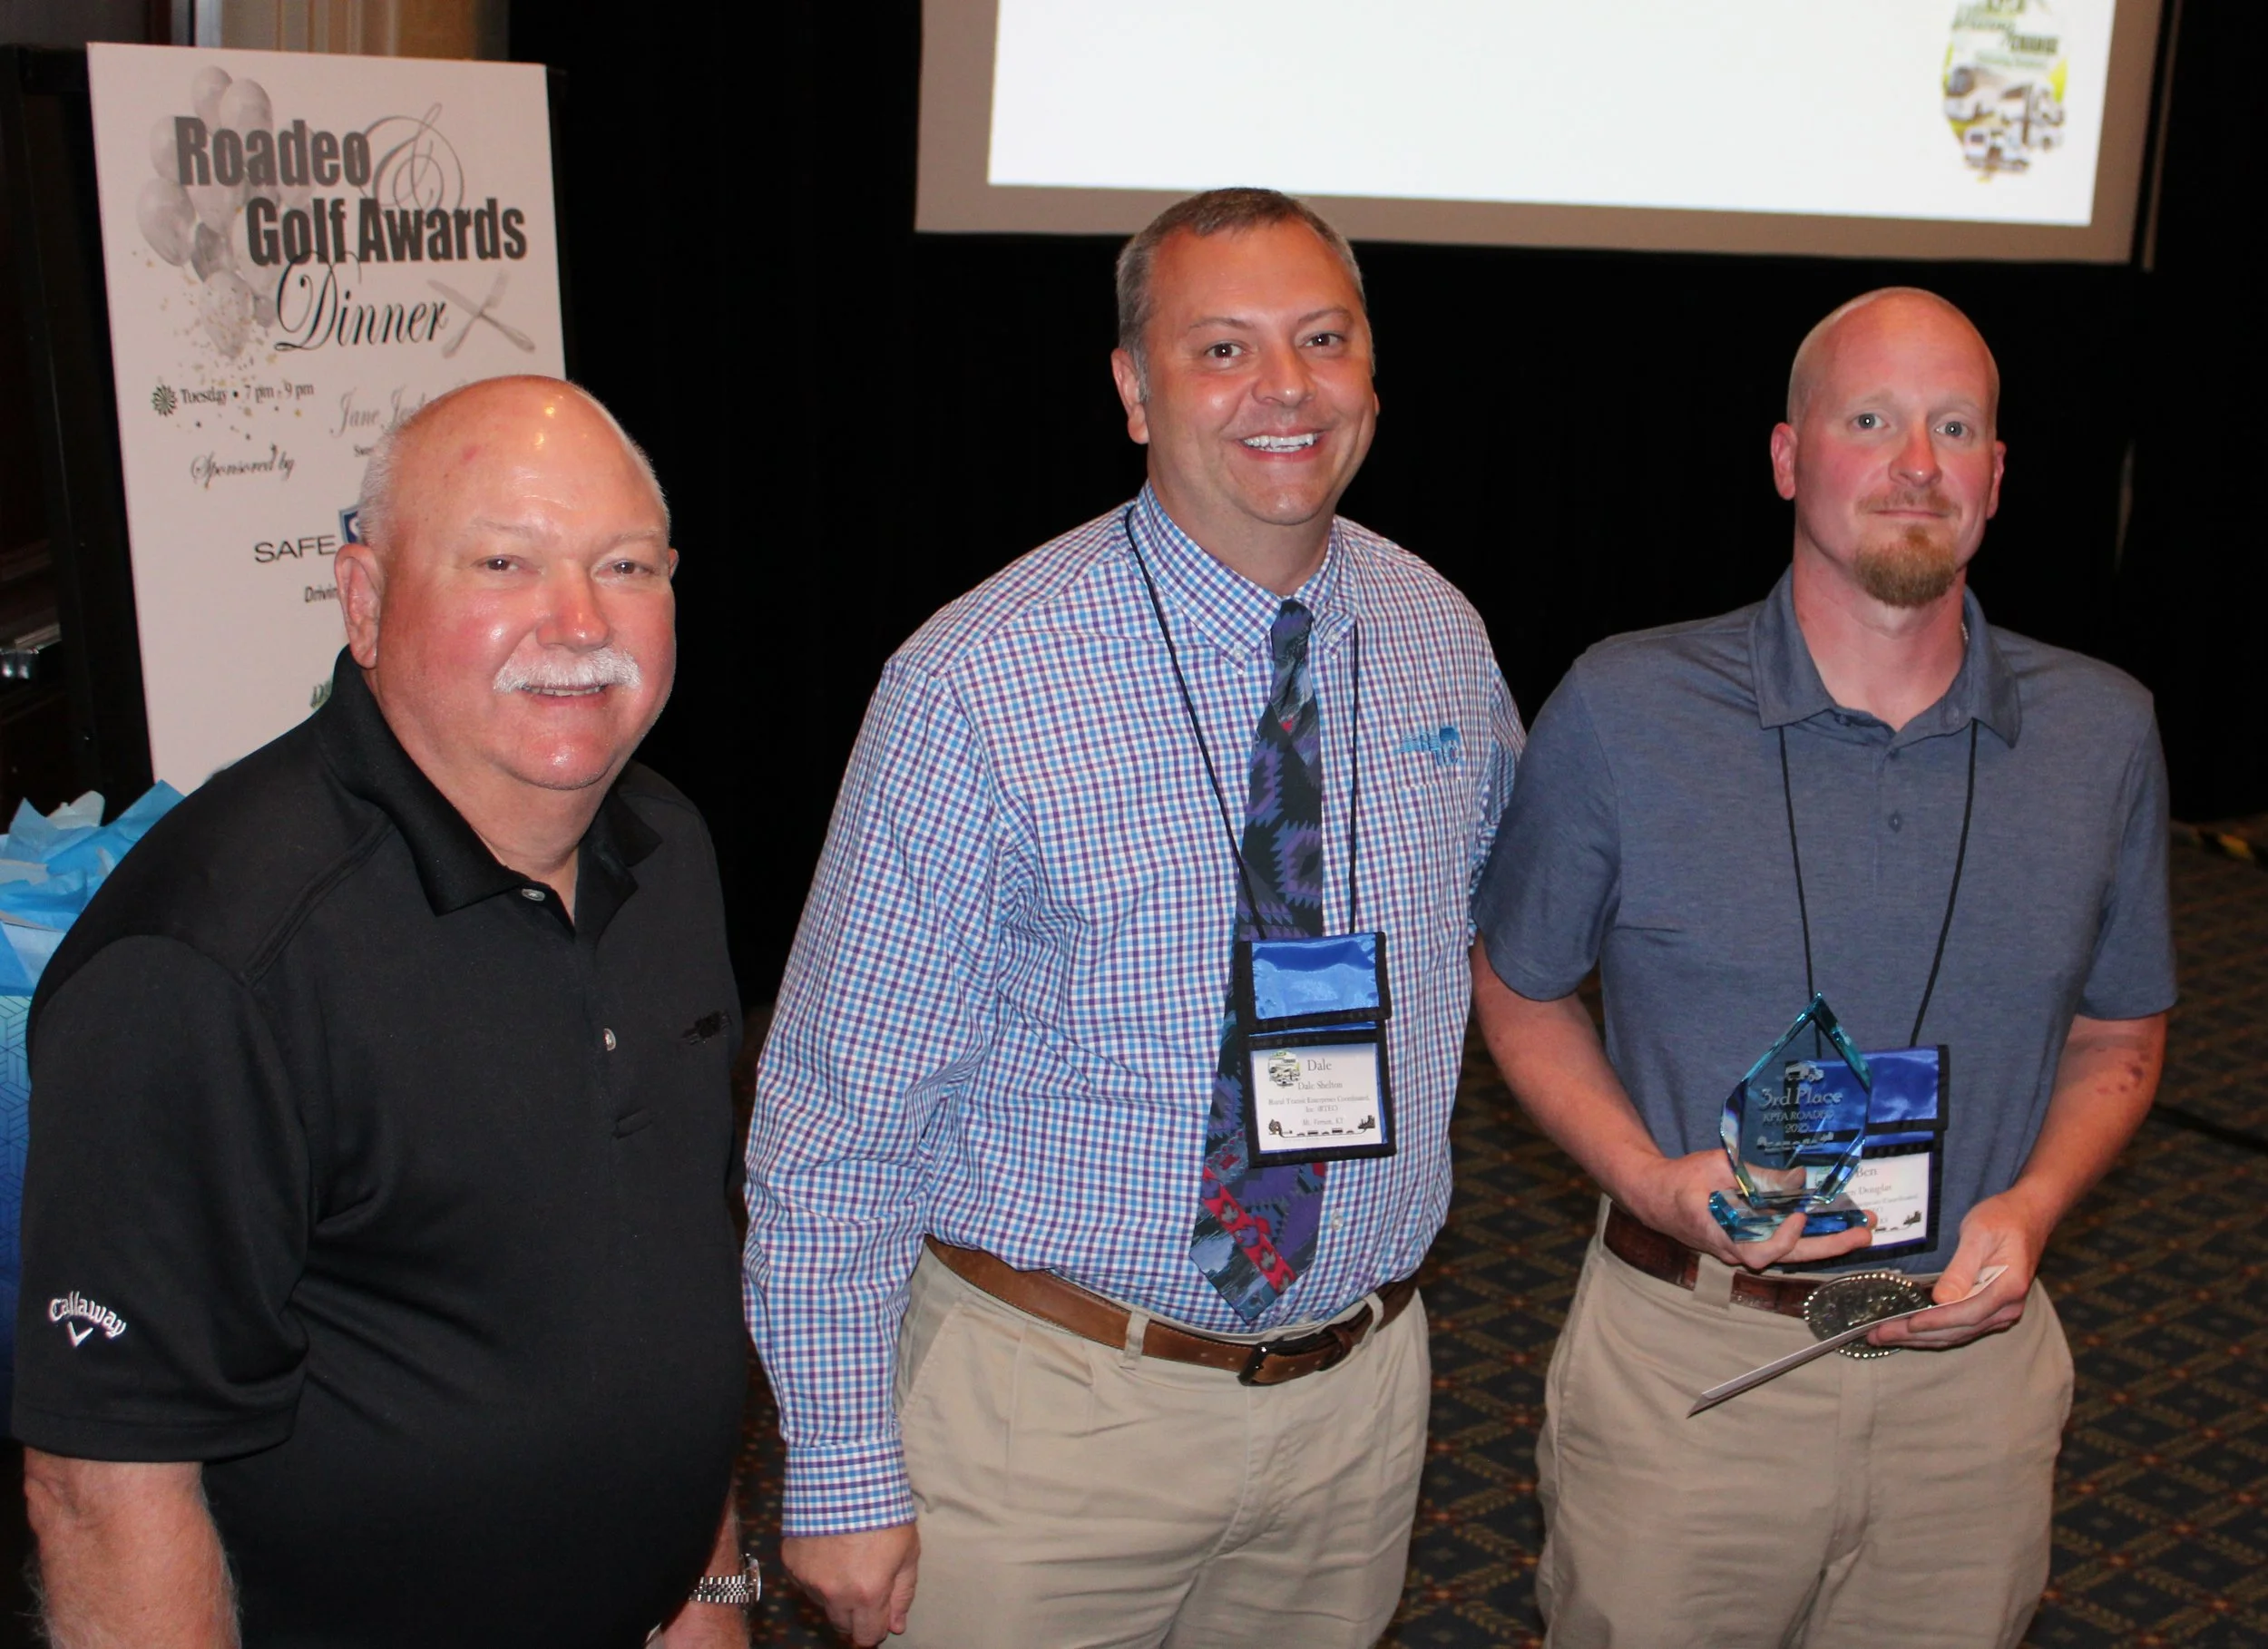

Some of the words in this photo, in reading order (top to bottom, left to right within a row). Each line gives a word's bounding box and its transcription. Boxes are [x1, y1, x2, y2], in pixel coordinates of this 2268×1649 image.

[174, 115, 371, 187] Roadeo
[245, 197, 346, 266] Golf
[357, 196, 527, 265] Awards
[273, 249, 449, 352] Dinner
[181, 385, 228, 405] Tuesday
[255, 385, 276, 404] pm
[295, 384, 315, 400] pm
[191, 443, 277, 489] Sponsored
[254, 534, 337, 563] SAFE
[1306, 1059, 1333, 1071] Dale
[1297, 1081, 1315, 1090] Dale
[1760, 1088, 1793, 1107] 3rd
[1795, 1086, 1843, 1106] Place
[47, 1291, 127, 1338] Callaway
